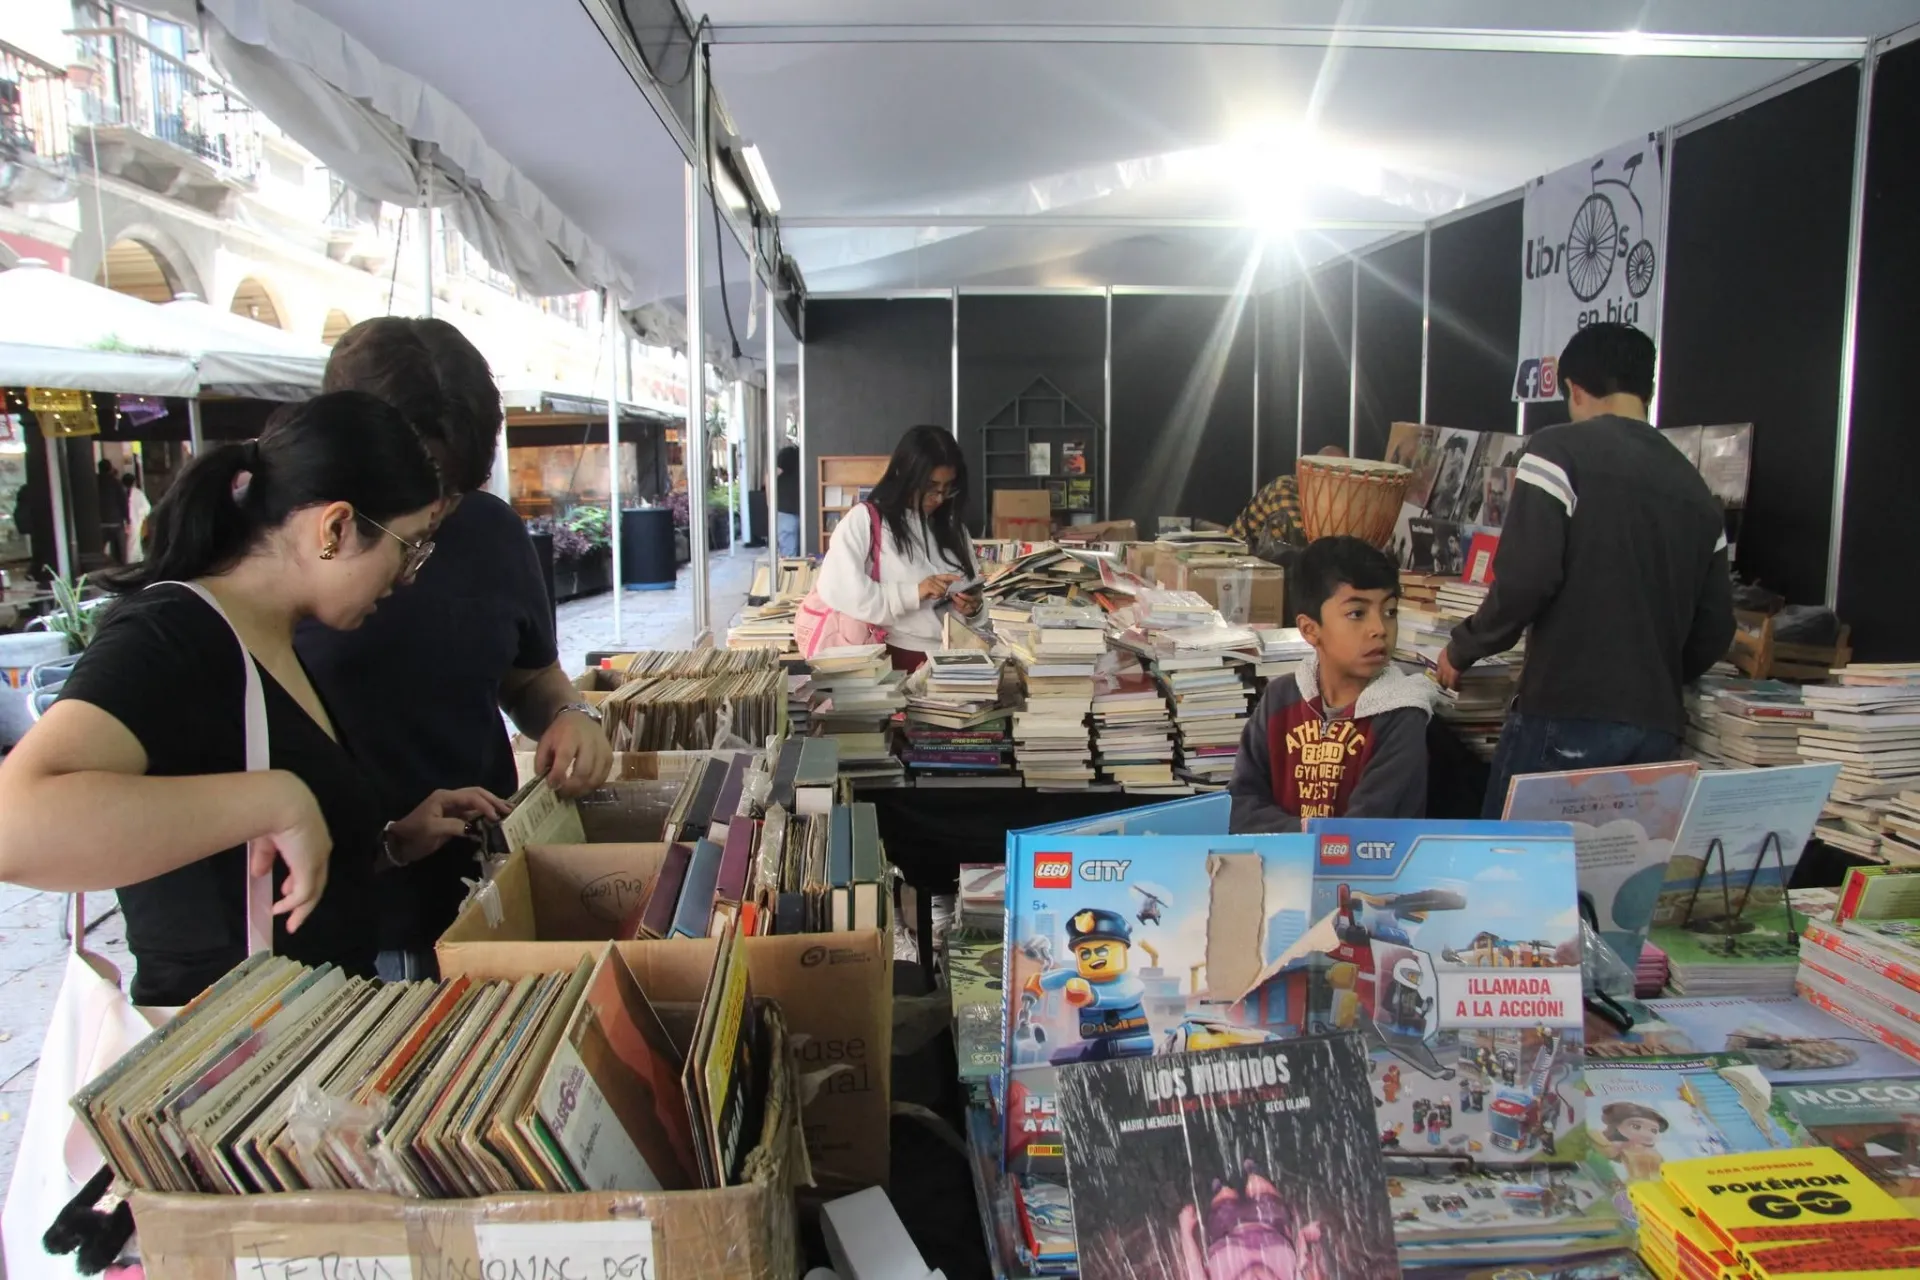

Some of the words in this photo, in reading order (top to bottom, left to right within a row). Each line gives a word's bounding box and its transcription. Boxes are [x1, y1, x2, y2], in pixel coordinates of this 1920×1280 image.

[1577, 309, 1600, 331] en
[1298, 781, 1339, 800] WEST
[1323, 843, 1349, 855] LEGO
[1356, 841, 1395, 859] CITY
[1035, 862, 1071, 878] LEGO
[1079, 860, 1131, 881] CITY
[1032, 900, 1048, 911] 5+
[1468, 978, 1551, 995] ¡LLAMADA
[1456, 1000, 1468, 1017] A
[1473, 1000, 1493, 1017] LA
[1499, 997, 1564, 1017] ACCIÓN!
[1145, 1067, 1187, 1100] LOS
[1023, 1119, 1037, 1132] A
[1119, 1118, 1144, 1133] MARIO
[1147, 1114, 1183, 1130] MENDOZA
[1707, 1174, 1850, 1195] POKÉMON
[1747, 1190, 1852, 1219] GO
